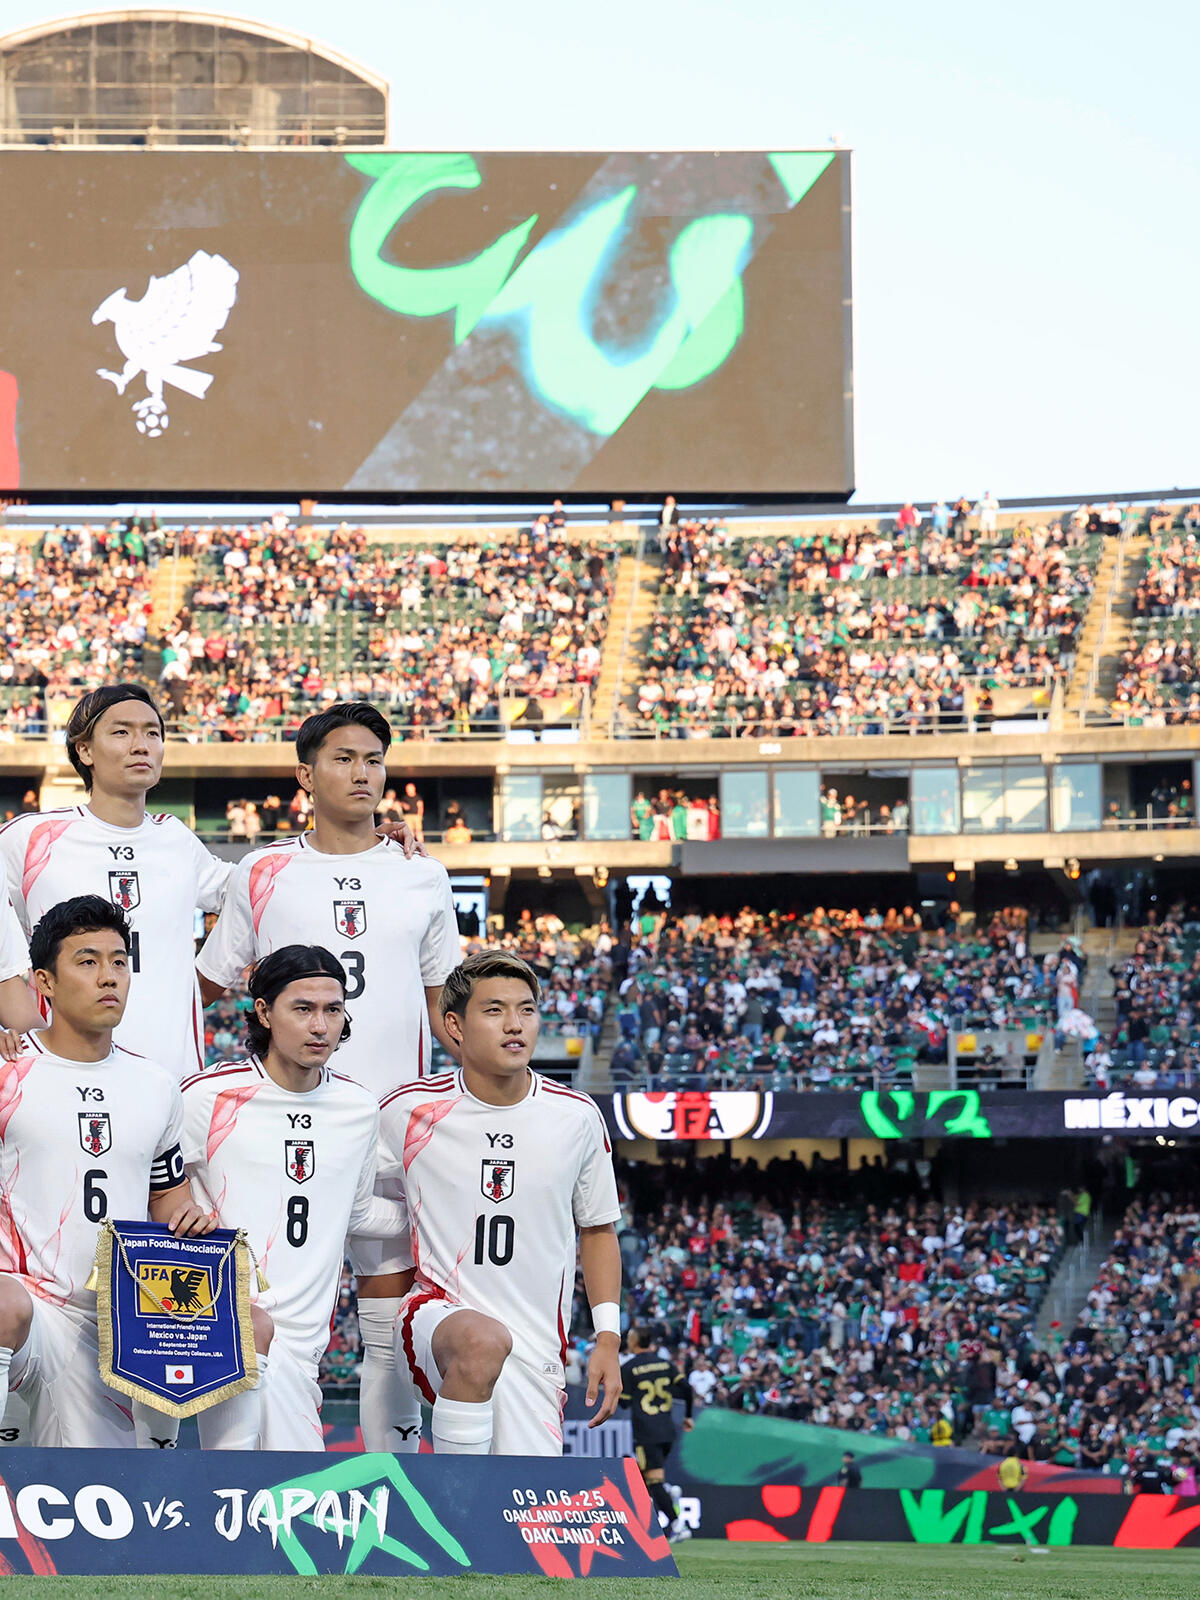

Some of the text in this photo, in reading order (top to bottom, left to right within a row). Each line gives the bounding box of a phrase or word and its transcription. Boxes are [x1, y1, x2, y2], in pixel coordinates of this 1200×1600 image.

[108, 846, 135, 860] Y-3
[333, 878, 361, 890] Y-3
[340, 951, 365, 1000] 3
[76, 1086, 104, 1102] Y-3
[1064, 1092, 1200, 1129] MÉXIC
[287, 1113, 312, 1129] Y-3
[661, 1108, 724, 1133] JFA
[485, 1133, 514, 1149] Y-3
[84, 1169, 108, 1224] 6
[287, 1195, 309, 1248] 8
[123, 1238, 226, 1255] Japan Football Association
[474, 1214, 515, 1267] 10
[141, 1268, 169, 1281] JFA
[149, 1331, 174, 1339] Mexico
[186, 1332, 207, 1341] Japan
[637, 1377, 672, 1415] 25
[512, 1489, 605, 1507] 09.06.25
[213, 1485, 390, 1550] JAPAN
[502, 1509, 628, 1524] OAKLAND COLISEUM
[521, 1528, 625, 1546] OAKLAND, CA
